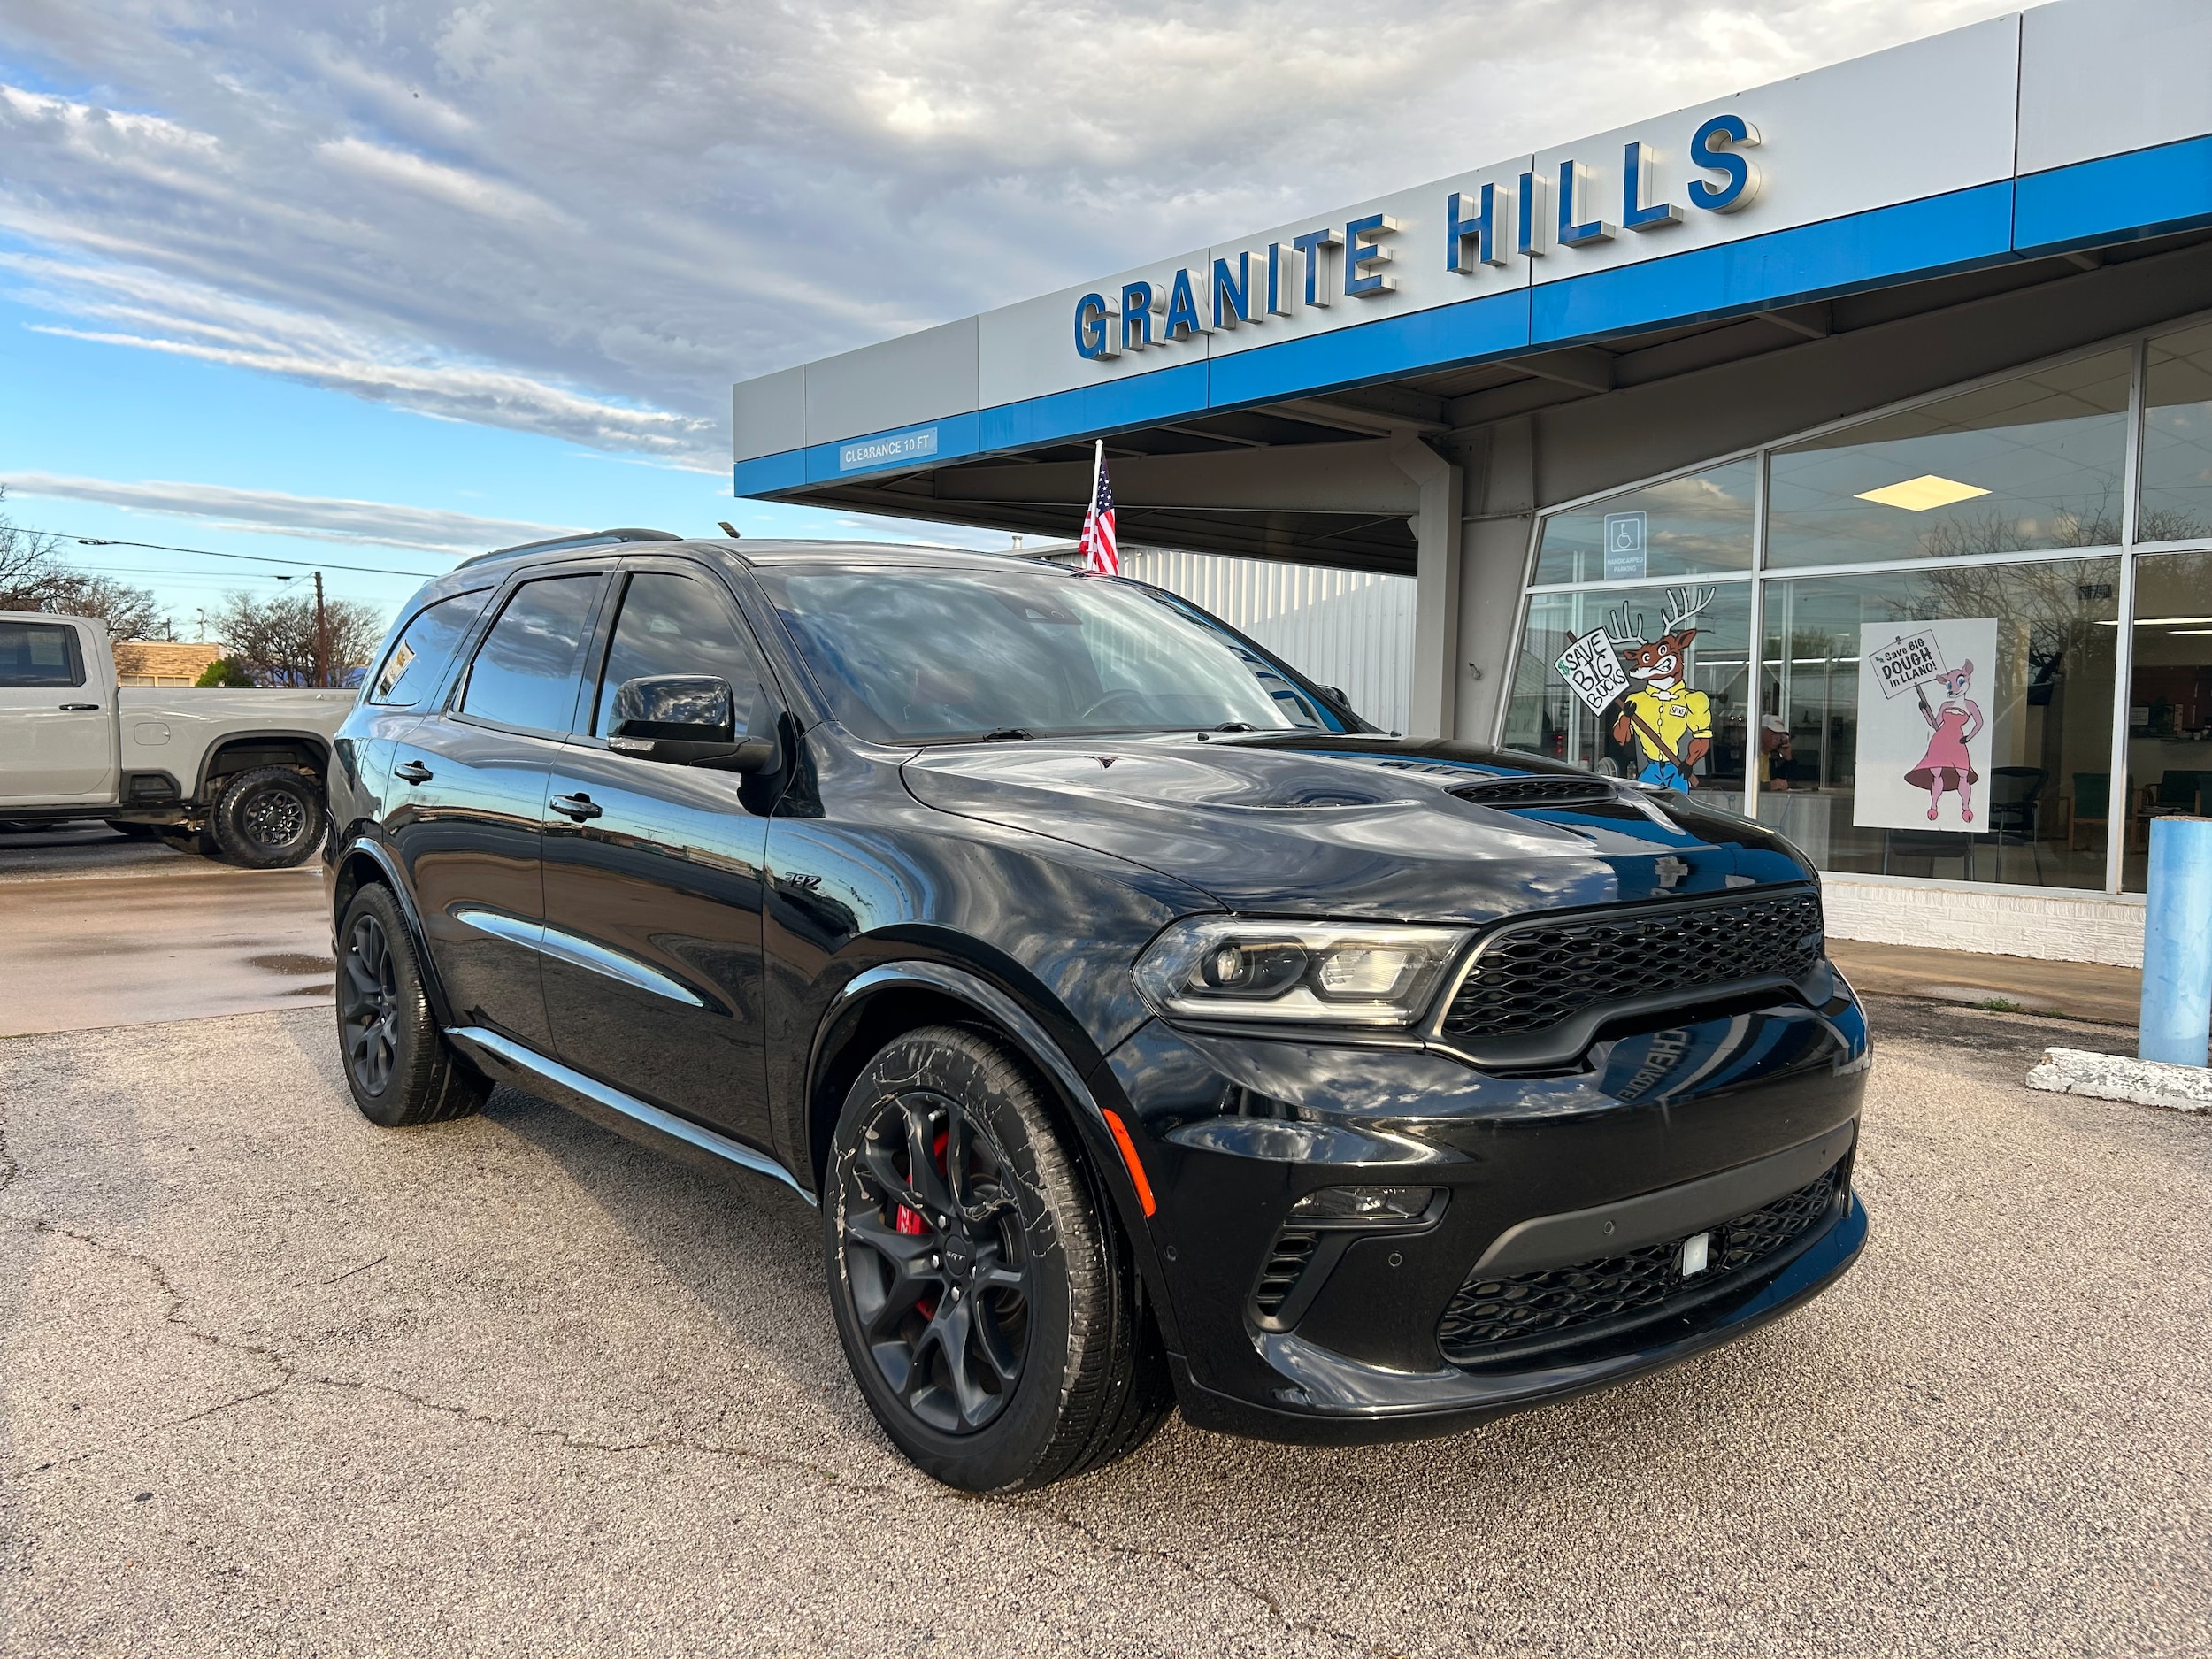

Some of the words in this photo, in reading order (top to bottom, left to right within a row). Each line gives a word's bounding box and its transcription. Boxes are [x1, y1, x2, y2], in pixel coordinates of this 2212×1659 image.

[1074, 212, 1397, 362] GRANITE
[1446, 113, 1762, 275] HILLS
[845, 441, 902, 463] CLEARANCE
[904, 438, 915, 451] 10
[917, 434, 930, 449] FT
[1607, 556, 1643, 565] HANDICAPPED
[1881, 646, 1932, 680] DOUGH
[1885, 647, 1908, 661] Save
[1908, 638, 1925, 651] BIG
[1572, 654, 1613, 692] BIG
[1889, 679, 1901, 688] in
[1900, 660, 1938, 683] LLANO!
[1586, 668, 1626, 709] BUCKS
[784, 872, 822, 890] 392
